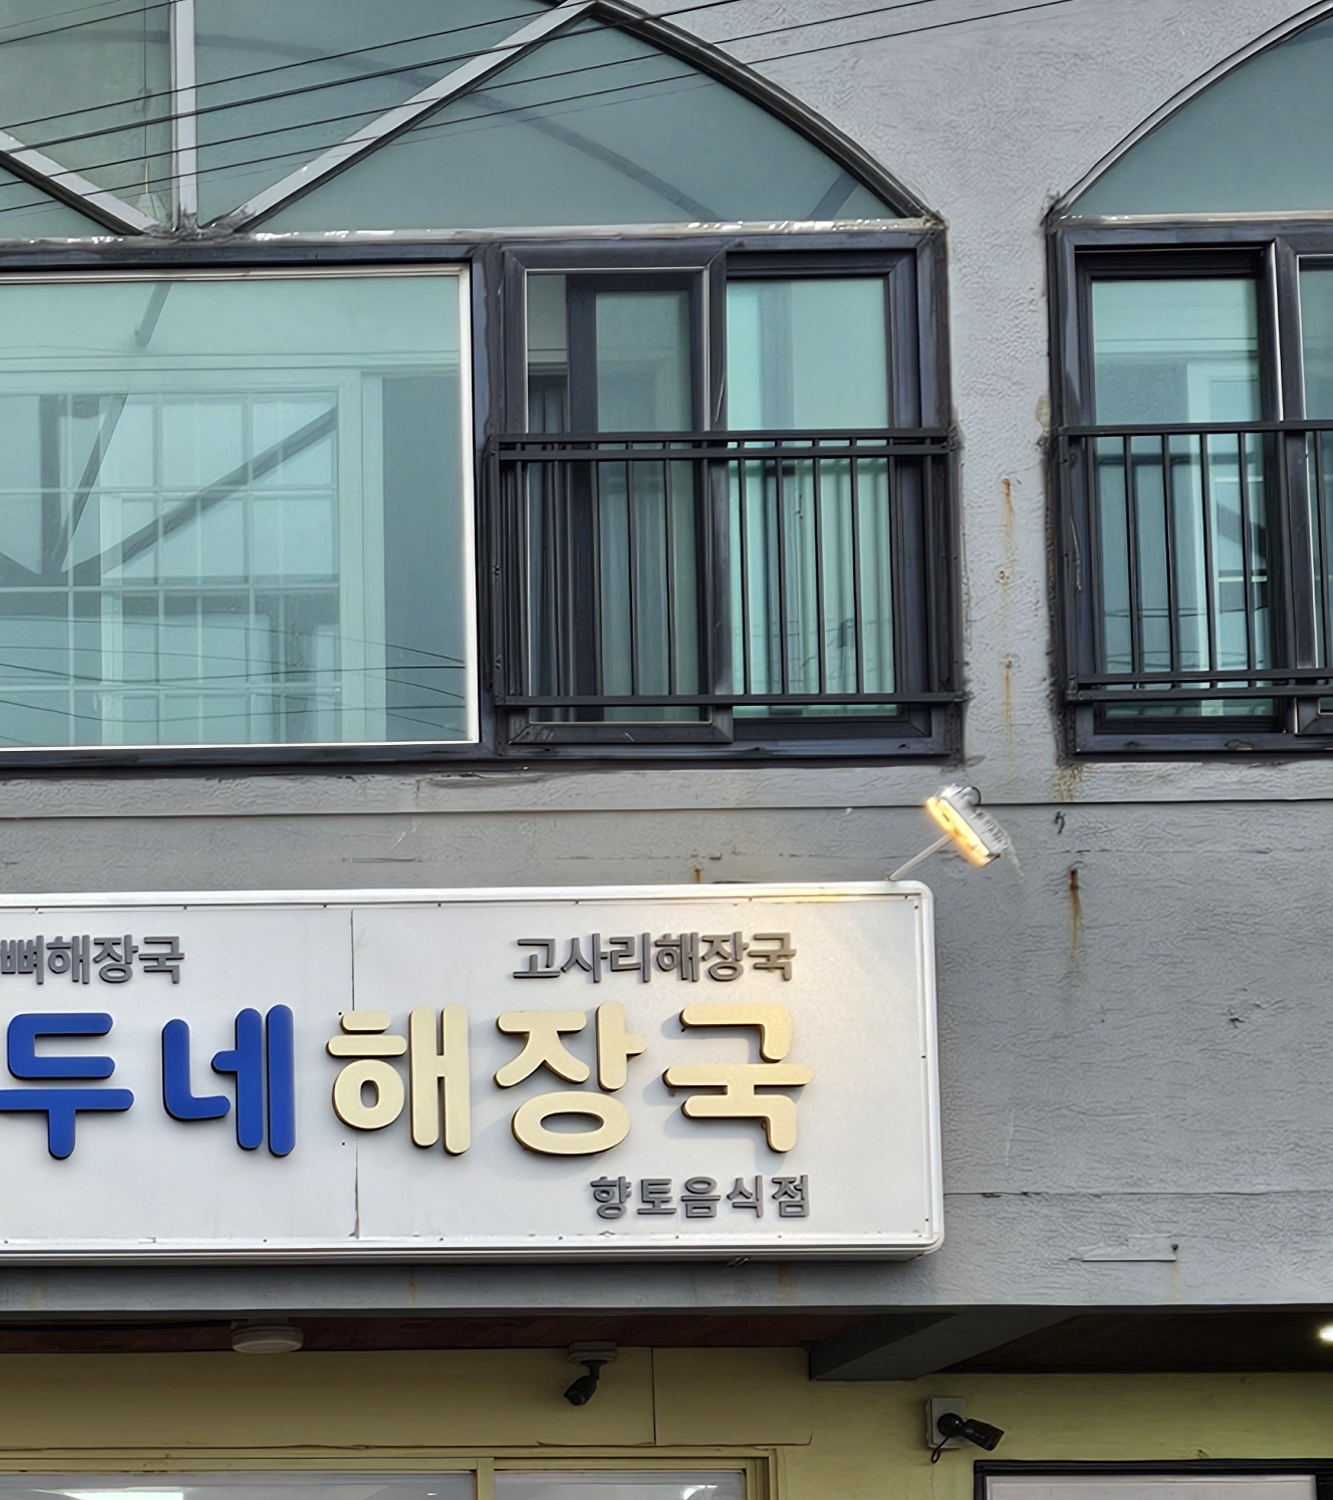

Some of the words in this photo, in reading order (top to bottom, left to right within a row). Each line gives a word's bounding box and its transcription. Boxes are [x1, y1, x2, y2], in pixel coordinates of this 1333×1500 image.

[512, 931, 798, 984] 고사리해장국
[327, 999, 815, 1158] 해장국
[589, 1174, 809, 1221] 향토음식점
